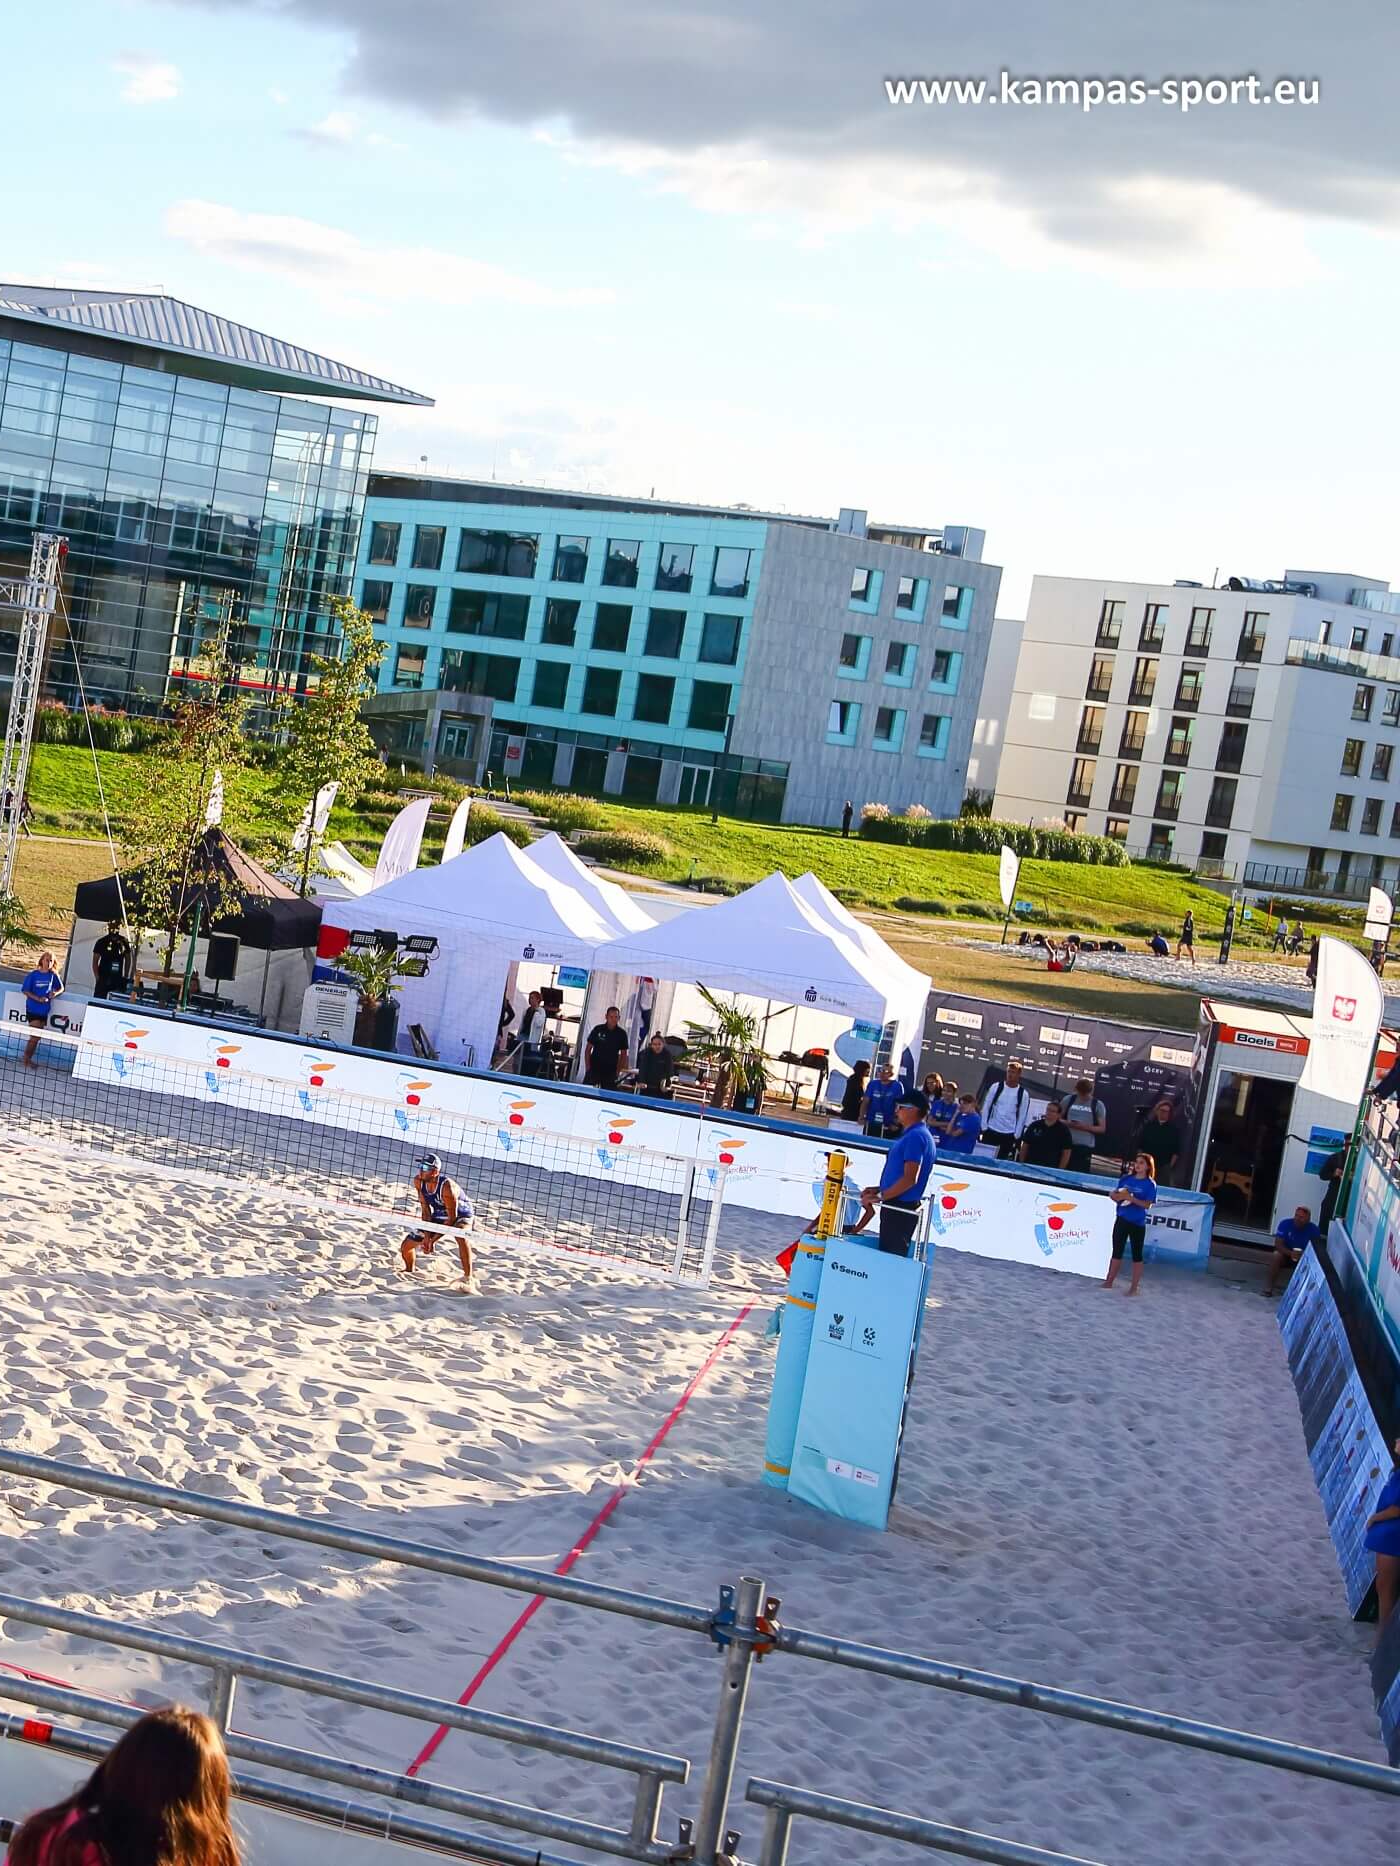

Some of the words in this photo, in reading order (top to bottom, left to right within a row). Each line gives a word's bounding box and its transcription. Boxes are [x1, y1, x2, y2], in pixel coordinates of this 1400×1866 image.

[9, 1009, 28, 1024] Ro
[50, 1013, 84, 1035] Qui
[1236, 1032, 1275, 1048] Boels
[839, 1265, 868, 1279] Senoh
[863, 1339, 875, 1347] CEV
